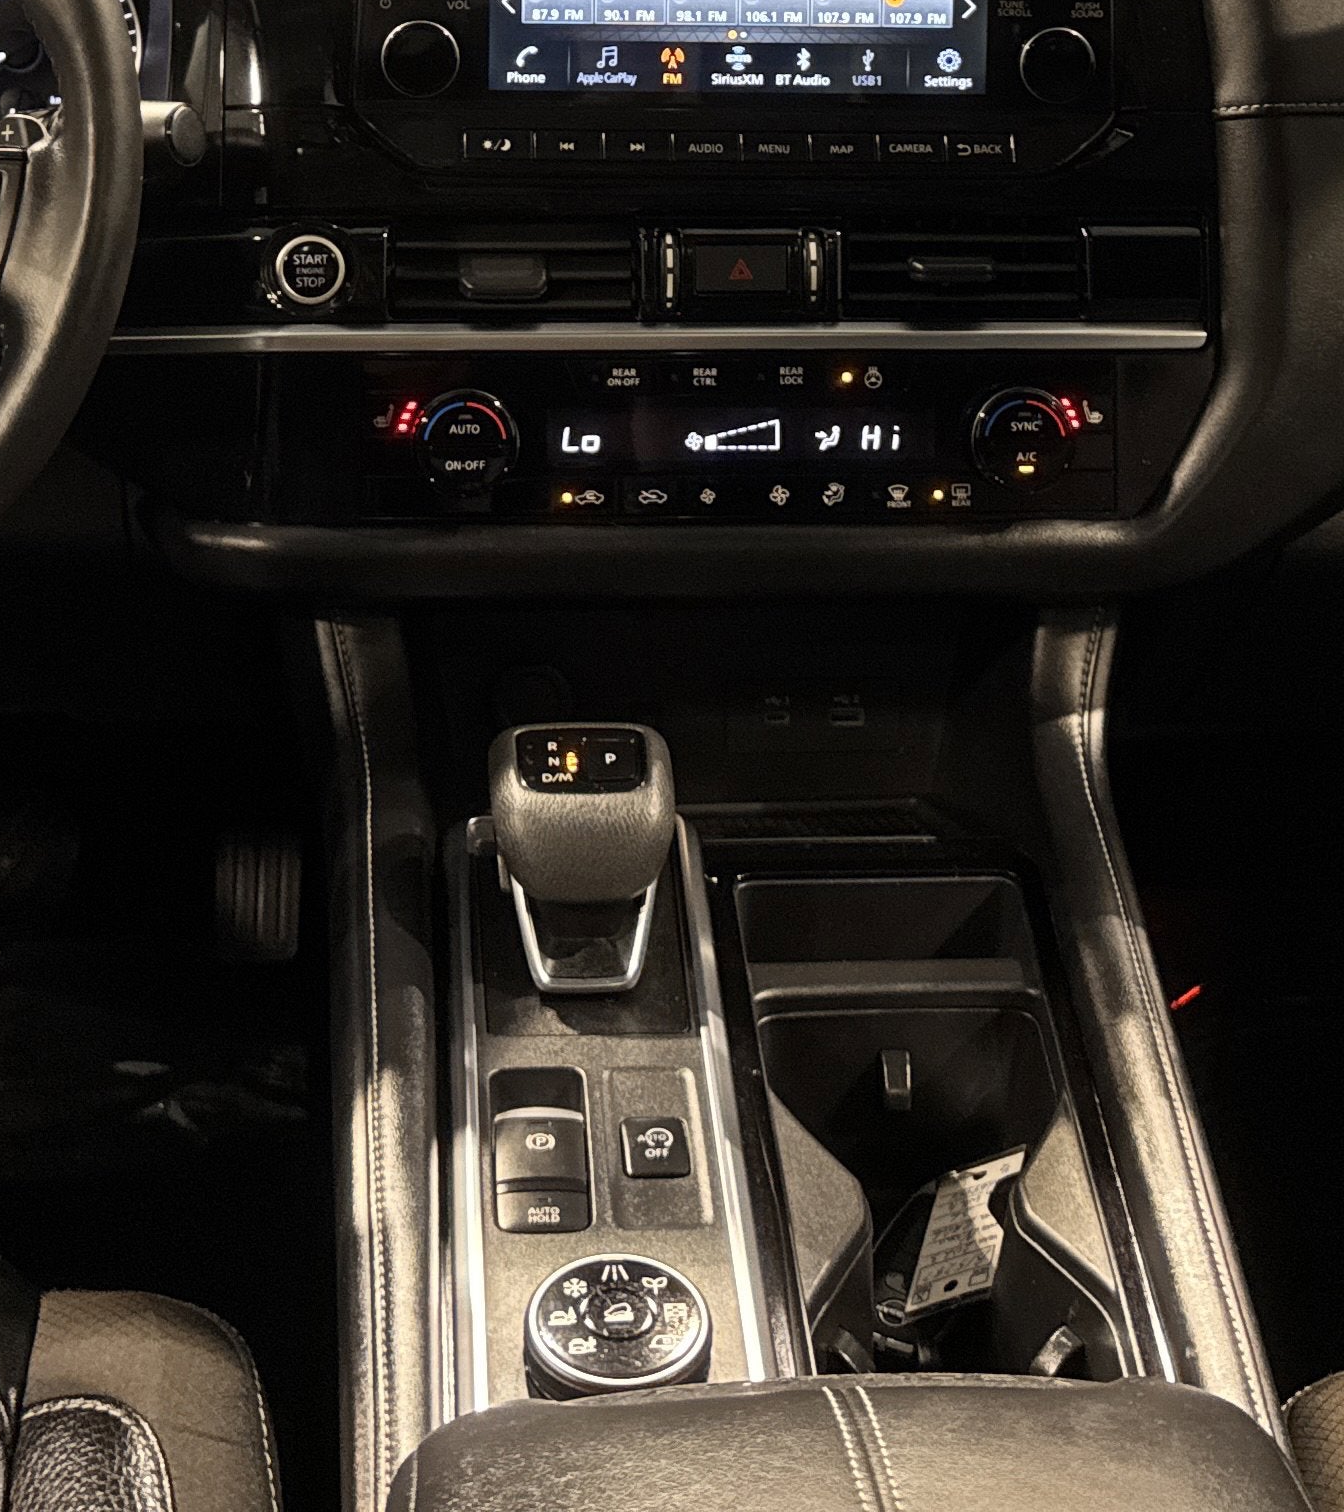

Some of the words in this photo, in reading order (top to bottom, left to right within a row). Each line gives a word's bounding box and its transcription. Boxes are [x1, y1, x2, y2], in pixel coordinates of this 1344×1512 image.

[446, 0, 471, 10] VOL
[532, 9, 559, 21] 87.9
[564, 9, 583, 21] FM
[604, 9, 629, 21] 90.1
[636, 10, 655, 21] FM
[676, 10, 701, 22] 98.1
[708, 10, 727, 22] FM
[745, 11, 777, 22] 106.1
[783, 12, 803, 23] FM
[817, 12, 850, 24] 107.9
[855, 12, 874, 24] FM
[998, 9, 1032, 17] SCROLL
[1071, 10, 1104, 18] SOUND
[889, 13, 922, 24] 107.9
[927, 13, 947, 25] FM
[506, 72, 546, 84] Phone
[576, 72, 604, 85] Apple
[604, 72, 637, 86] CarPlay
[662, 73, 682, 85] FM
[711, 73, 764, 86] SiriusXM
[775, 74, 792, 85] BT
[793, 74, 831, 86] Audio
[852, 75, 882, 87] USB1
[924, 75, 973, 90] Settings
[688, 143, 723, 153] AUDIO
[758, 144, 790, 154] MENU
[830, 144, 854, 154] MAP
[889, 144, 933, 154] CAMERA
[974, 144, 1002, 154] BACK
[293, 254, 328, 265] START
[296, 277, 325, 287] STOP
[612, 368, 637, 376] REAR
[693, 368, 717, 376] REAR
[780, 367, 803, 376] REAR
[693, 377, 717, 386] CTRL
[780, 376, 803, 385] LOCK
[449, 424, 481, 435] AUTO
[1010, 422, 1039, 432] SYNC
[561, 426, 601, 453] Lo
[861, 424, 901, 451] Hi
[1016, 451, 1037, 462] A/C
[547, 741, 558, 751] R
[548, 756, 560, 767] N
[604, 752, 616, 765] P
[541, 772, 574, 783] D/M
[644, 1148, 670, 1159] OFF
[528, 1206, 560, 1215] AUTO
[528, 1215, 560, 1224] HOLD
